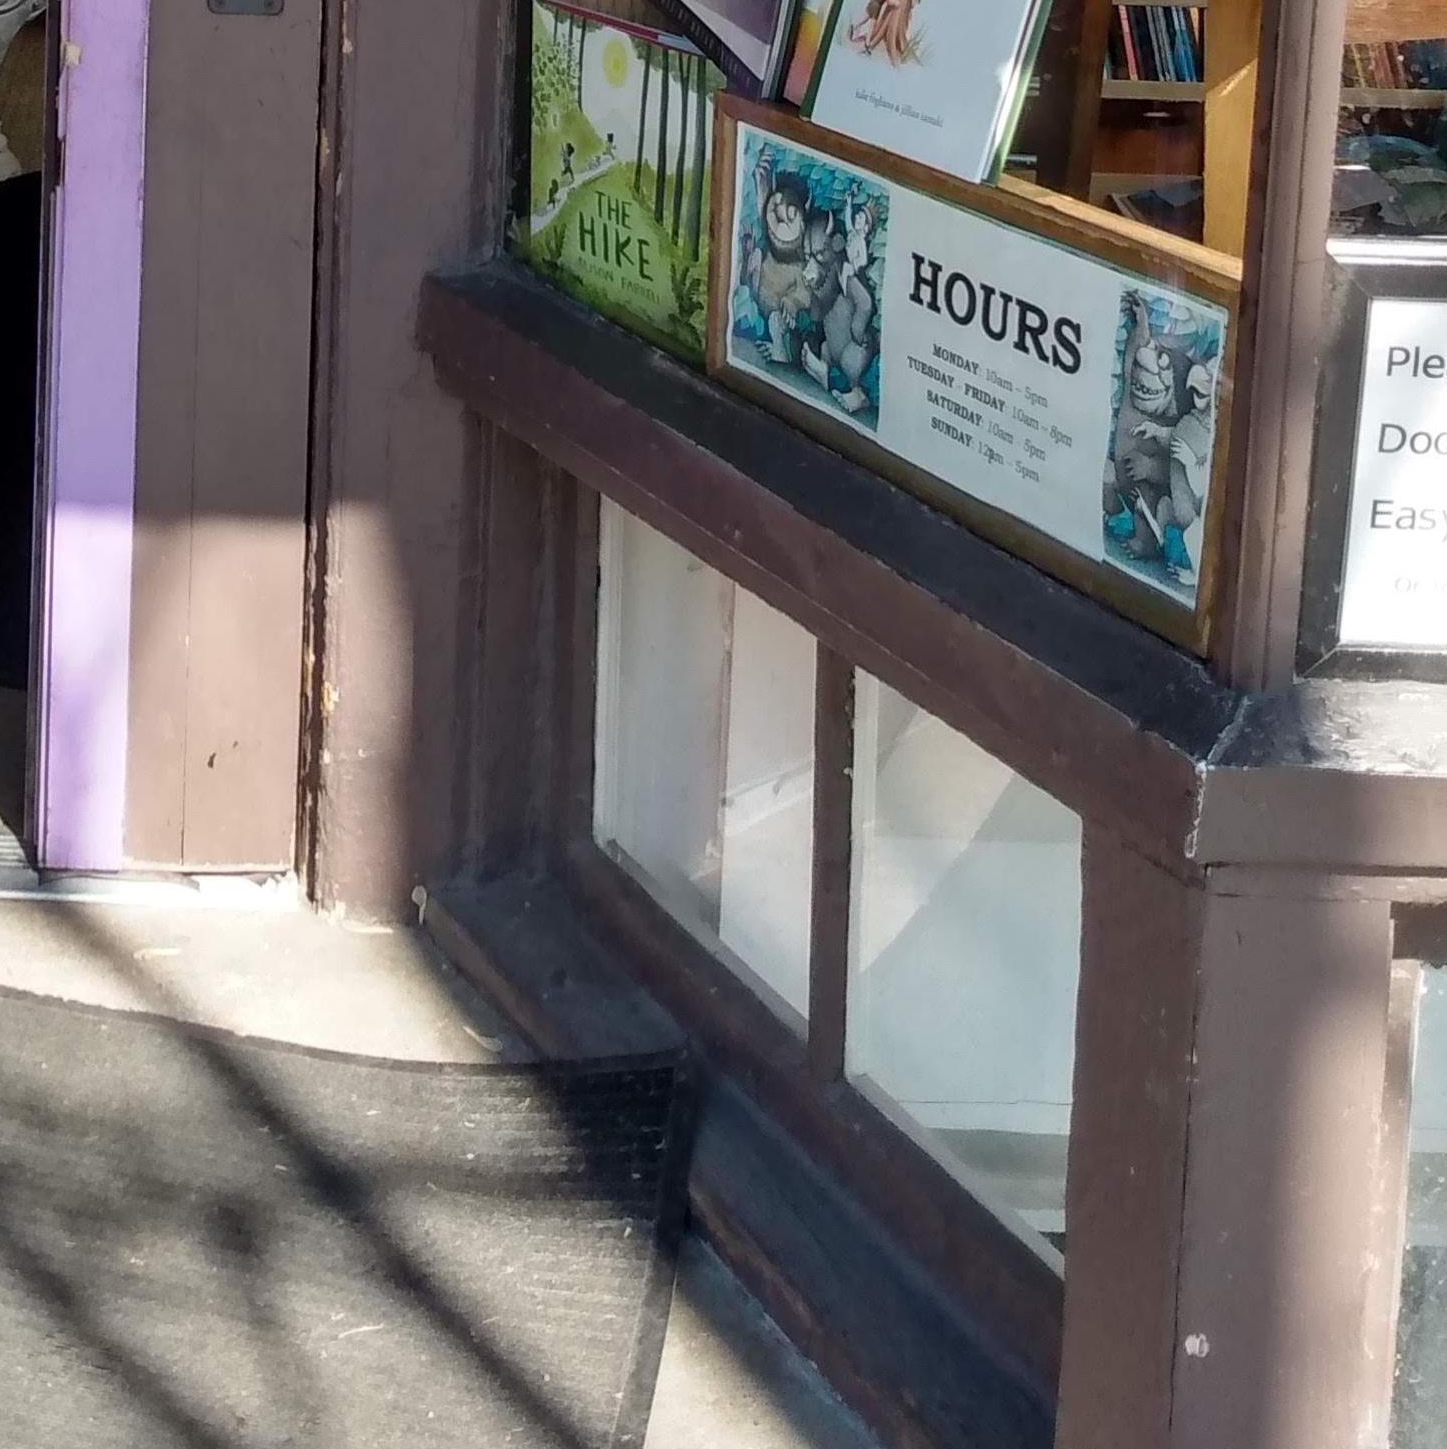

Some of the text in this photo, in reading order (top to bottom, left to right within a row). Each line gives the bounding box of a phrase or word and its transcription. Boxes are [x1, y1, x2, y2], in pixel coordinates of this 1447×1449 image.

[595, 190, 632, 230] THE
[579, 210, 654, 282] HIKE
[908, 251, 1082, 374] HOURS
[1386, 345, 1447, 380] Ple
[906, 355, 955, 389] TUESDAY
[1012, 405, 1040, 431] 10am
[1049, 424, 1073, 448] 8pm
[985, 368, 1013, 393] 10am
[1025, 385, 1049, 409] 5pm
[1023, 437, 1046, 462] 5pm
[1015, 459, 1040, 483] 5pm
